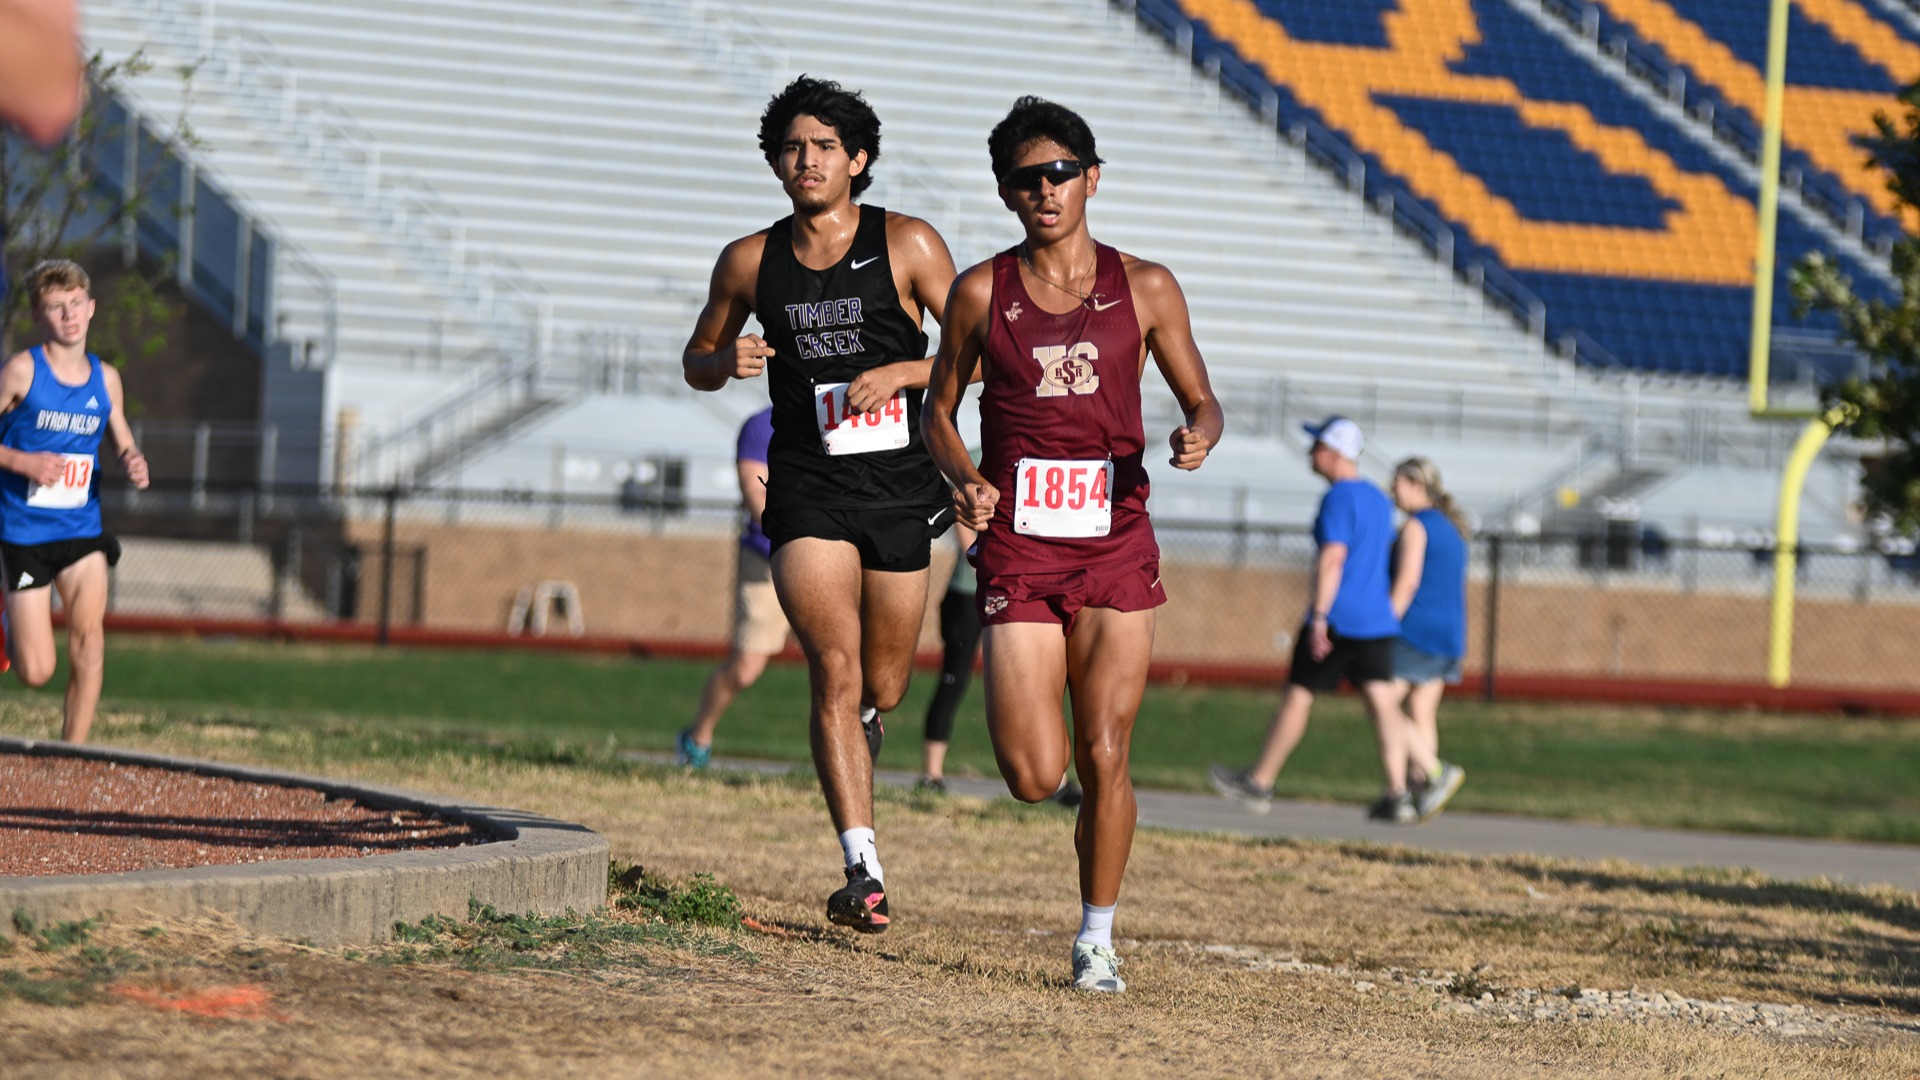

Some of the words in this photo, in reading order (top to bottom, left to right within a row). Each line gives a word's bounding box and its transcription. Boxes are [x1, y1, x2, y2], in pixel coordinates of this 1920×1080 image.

[785, 297, 864, 330] TIMBER
[796, 329, 865, 360] CREEK
[36, 410, 71, 432] BYRON
[69, 413, 101, 435] NELSON
[1023, 466, 1108, 510] 1854
